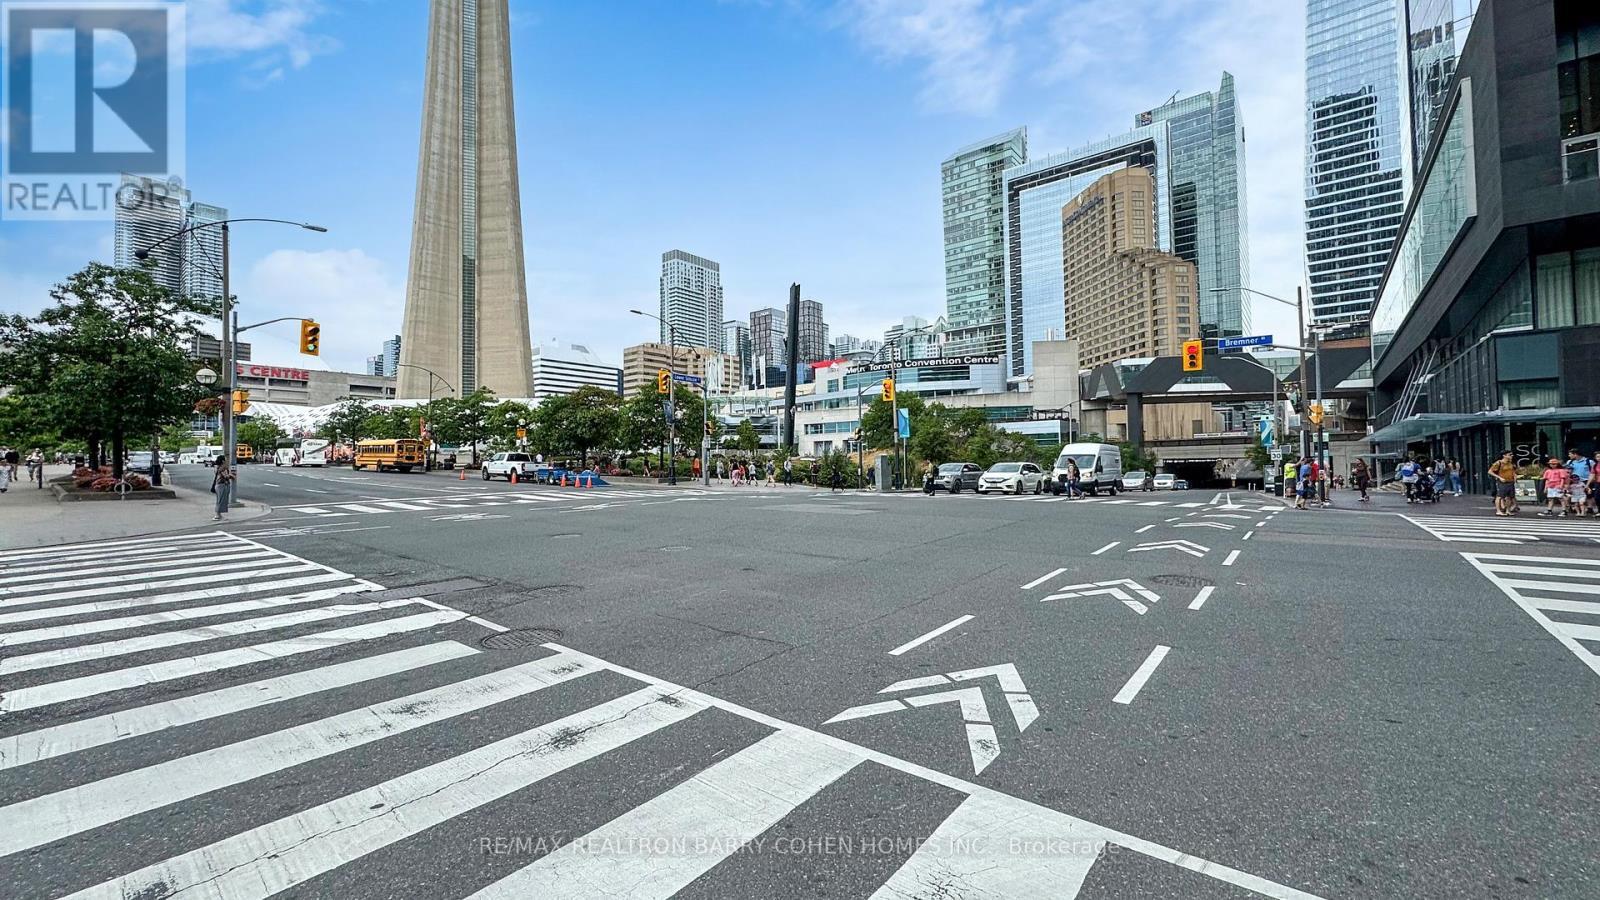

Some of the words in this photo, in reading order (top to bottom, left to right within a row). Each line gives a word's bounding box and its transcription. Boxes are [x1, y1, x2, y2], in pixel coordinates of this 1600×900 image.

[1225, 338, 1259, 347] Bremner
[868, 362, 903, 371] Toronto
[904, 356, 962, 368] Convention
[963, 355, 999, 364] Centre
[250, 366, 310, 380] CENTRE
